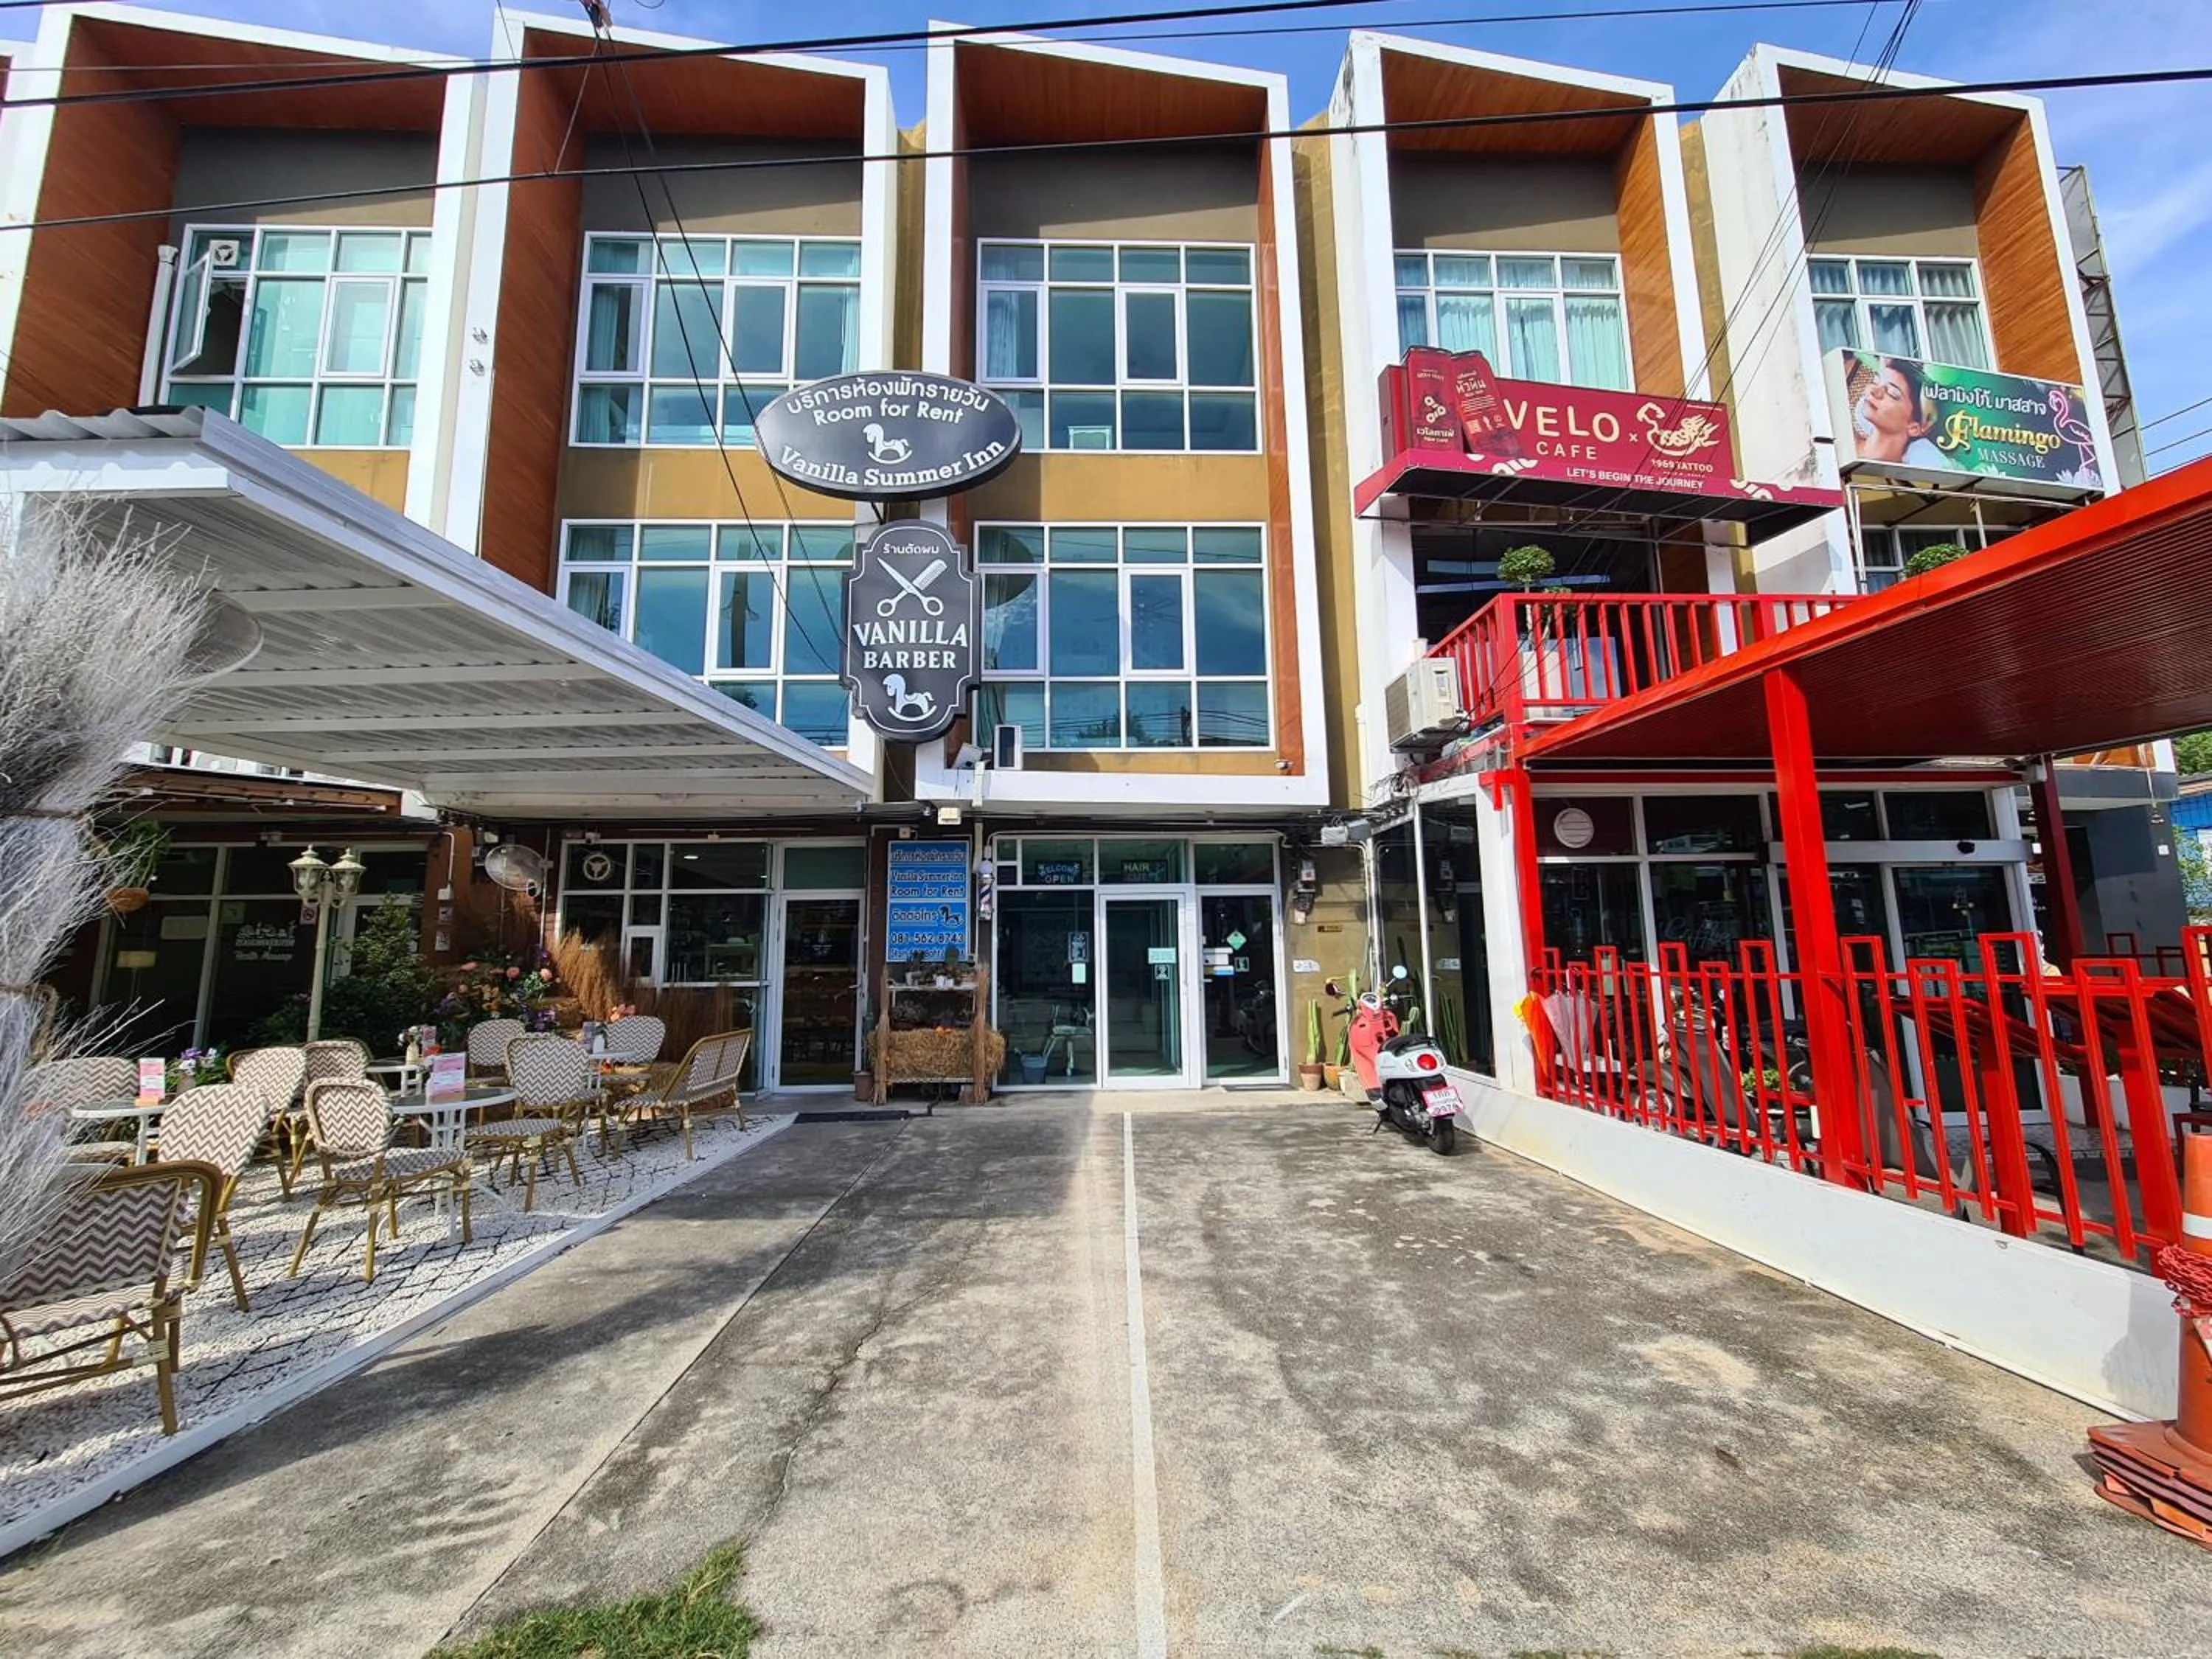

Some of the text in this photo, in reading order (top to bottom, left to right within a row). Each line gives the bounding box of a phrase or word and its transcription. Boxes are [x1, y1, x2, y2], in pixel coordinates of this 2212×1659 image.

[787, 375, 990, 414] บริการห้องพักรายวัน
[813, 398, 964, 425] Room for Rent
[1503, 398, 1621, 442] VELO
[1936, 410, 2061, 454] Flamingo
[1536, 441, 1597, 460] CAFE
[1977, 448, 2045, 469] MASSAGE
[780, 439, 1006, 487] Vanilla Summer Inn
[1675, 461, 1714, 473] TATTOO
[1566, 467, 1597, 479] LET'S
[1598, 470, 1632, 482] BEGIN
[1633, 473, 1655, 484] THE
[1655, 476, 1705, 489] JOURNEY
[883, 542, 940, 554] ร้านตัดผม
[852, 619, 968, 647] VANILLA
[863, 650, 956, 669] BARBER
[1123, 862, 1150, 872] HAIR
[1044, 875, 1074, 884] OPEN
[891, 883, 966, 897] Room for Rent
[914, 932, 934, 944] 562
